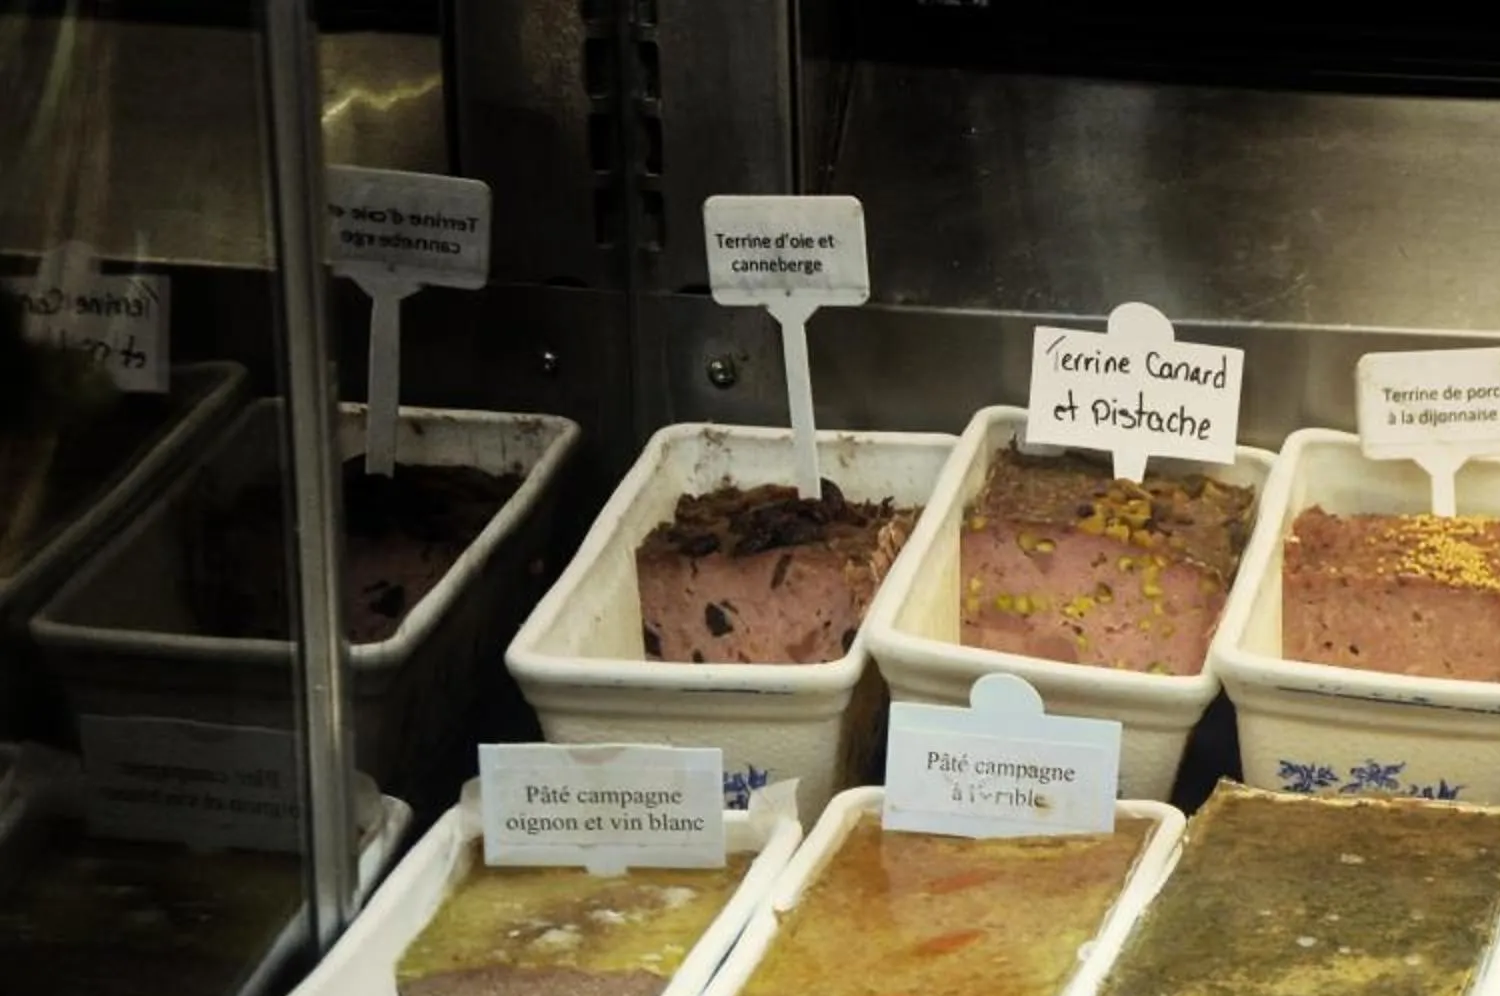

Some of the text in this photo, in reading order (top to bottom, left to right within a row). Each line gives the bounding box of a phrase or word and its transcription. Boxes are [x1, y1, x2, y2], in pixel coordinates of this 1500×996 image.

[715, 232, 835, 249] Terrine d'oie et
[732, 257, 823, 275] canneberge
[1046, 335, 1227, 389] Terrine Canard
[1054, 389, 1078, 421] et
[1382, 387, 1439, 403] Terrine
[1443, 385, 1462, 400] de
[1388, 407, 1498, 427] à la dijonnaise
[927, 751, 1076, 785] Pâté campagne
[525, 785, 683, 809] Pâté campagne
[506, 812, 705, 835] oignon et vin blanc
